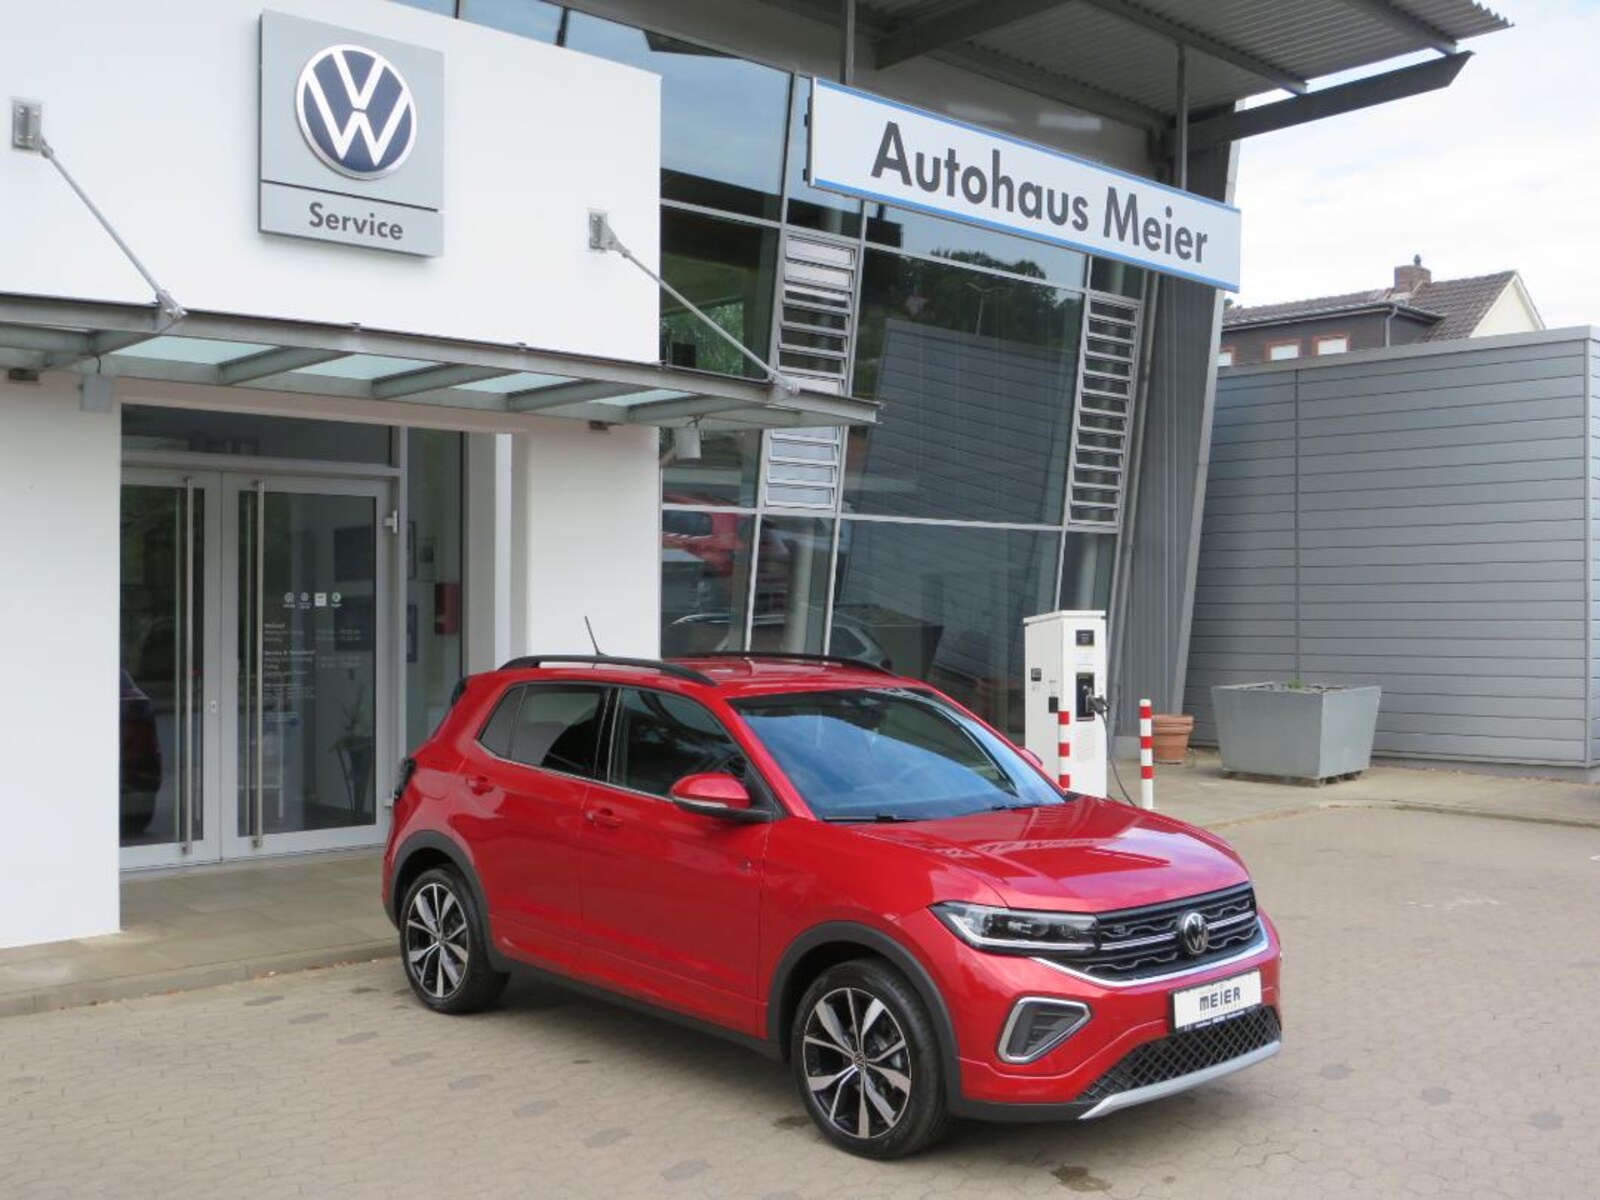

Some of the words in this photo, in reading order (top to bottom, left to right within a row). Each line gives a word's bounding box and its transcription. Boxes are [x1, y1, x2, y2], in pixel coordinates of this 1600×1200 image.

[300, 46, 412, 168] VW
[308, 202, 404, 241] Service
[871, 120, 1089, 232] Autohaus
[1102, 186, 1208, 263] Meier
[1199, 986, 1241, 1011] MEIER
